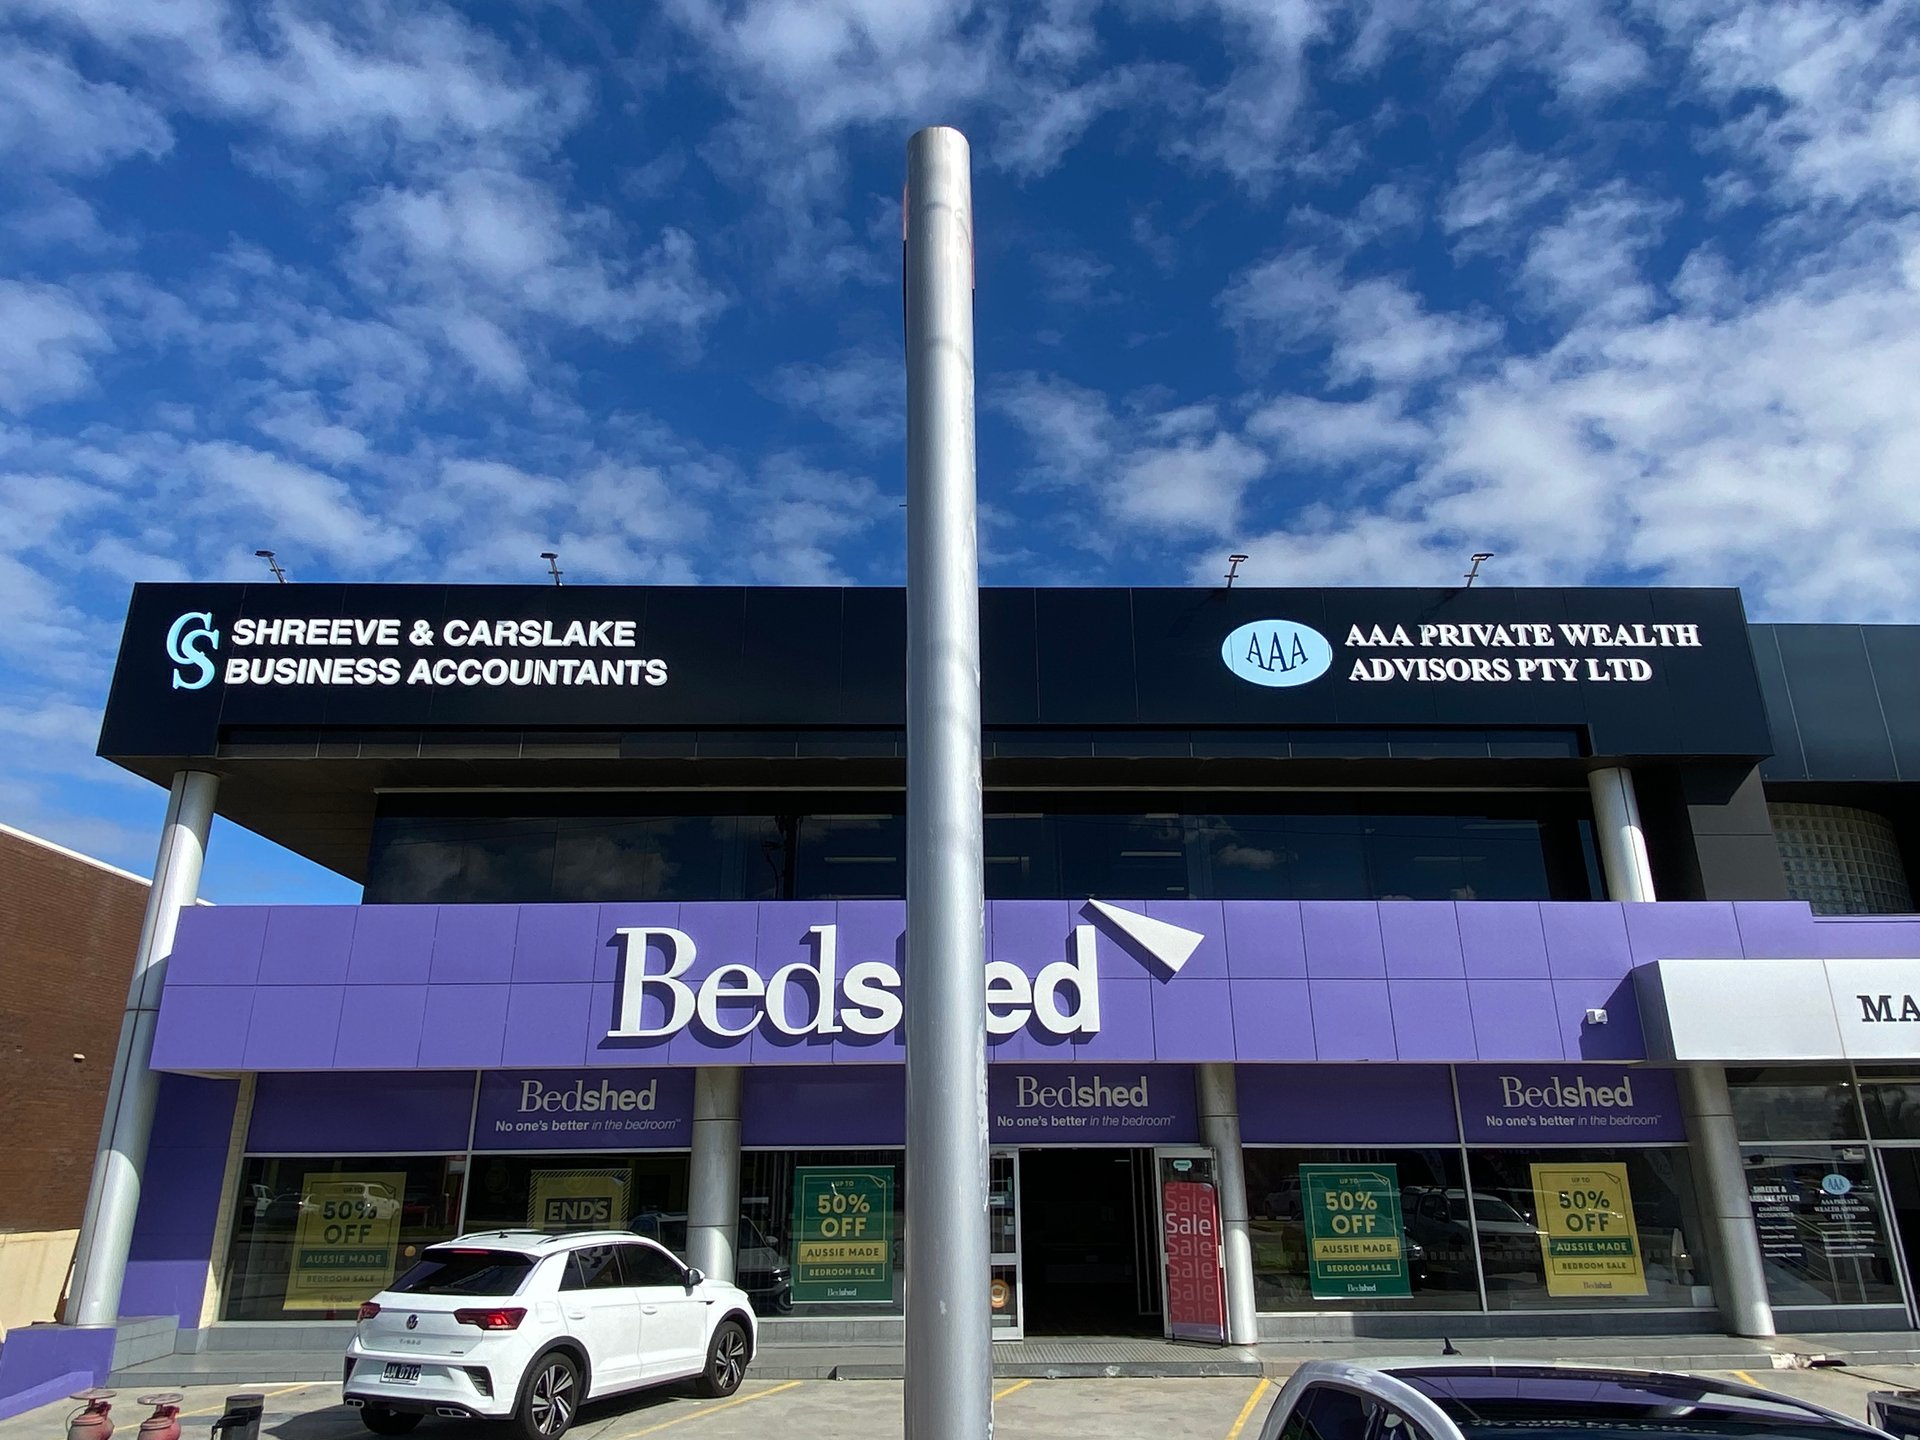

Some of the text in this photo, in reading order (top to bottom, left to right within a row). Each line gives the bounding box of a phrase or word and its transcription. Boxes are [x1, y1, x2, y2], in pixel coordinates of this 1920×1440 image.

[232, 619, 636, 647] SHREEVE & CARSLAKE
[1345, 624, 1703, 647] AAA PRIVATE WEALTH
[1246, 632, 1308, 672] AAA
[224, 657, 668, 686] BUSINESS ACCOUNTANTS
[1349, 658, 1653, 682] ADVISORS PTY LTD
[608, 924, 1101, 1037] Bedsed
[517, 1079, 657, 1112] Bedshed
[1016, 1076, 1149, 1107] Bedshed
[1499, 1075, 1634, 1107] Bedshed
[495, 1121, 512, 1131] No
[515, 1120, 548, 1131] one's
[551, 1120, 589, 1131] better
[591, 1119, 601, 1130] in
[605, 1119, 622, 1130] the
[997, 1116, 1014, 1127] No
[1016, 1115, 1048, 1127] one's
[1051, 1116, 1087, 1127] better
[1090, 1116, 1100, 1126] in
[1102, 1116, 1119, 1126] the
[1486, 1116, 1503, 1126] No
[1505, 1115, 1537, 1126] one's
[1540, 1116, 1575, 1126] better
[1578, 1115, 1588, 1126] in
[1590, 1115, 1607, 1126] the
[818, 1194, 870, 1214] 50%
[1165, 1190, 1211, 1214] Sale
[1325, 1191, 1377, 1211] 50%
[1558, 1190, 1610, 1209] 50%
[323, 1201, 377, 1219] 50%
[548, 1201, 608, 1220] ENDS
[821, 1217, 867, 1237] OFF
[1166, 1213, 1211, 1236] Sale
[1332, 1215, 1376, 1234] OFF
[1566, 1213, 1608, 1232] OFF
[324, 1224, 372, 1244] OFF
[807, 1248, 879, 1257] AUSSIE MADE
[1167, 1235, 1212, 1257] Sale
[1322, 1244, 1392, 1253] AUSSIE MADE
[1556, 1243, 1627, 1251] AUSSIE MADE
[305, 1255, 382, 1263] AUSSIE MADE
[1168, 1256, 1214, 1279] Sale
[1327, 1264, 1369, 1272] BEDROOM
[809, 1268, 851, 1276] BEDROOM
[1170, 1279, 1215, 1302] Sale
